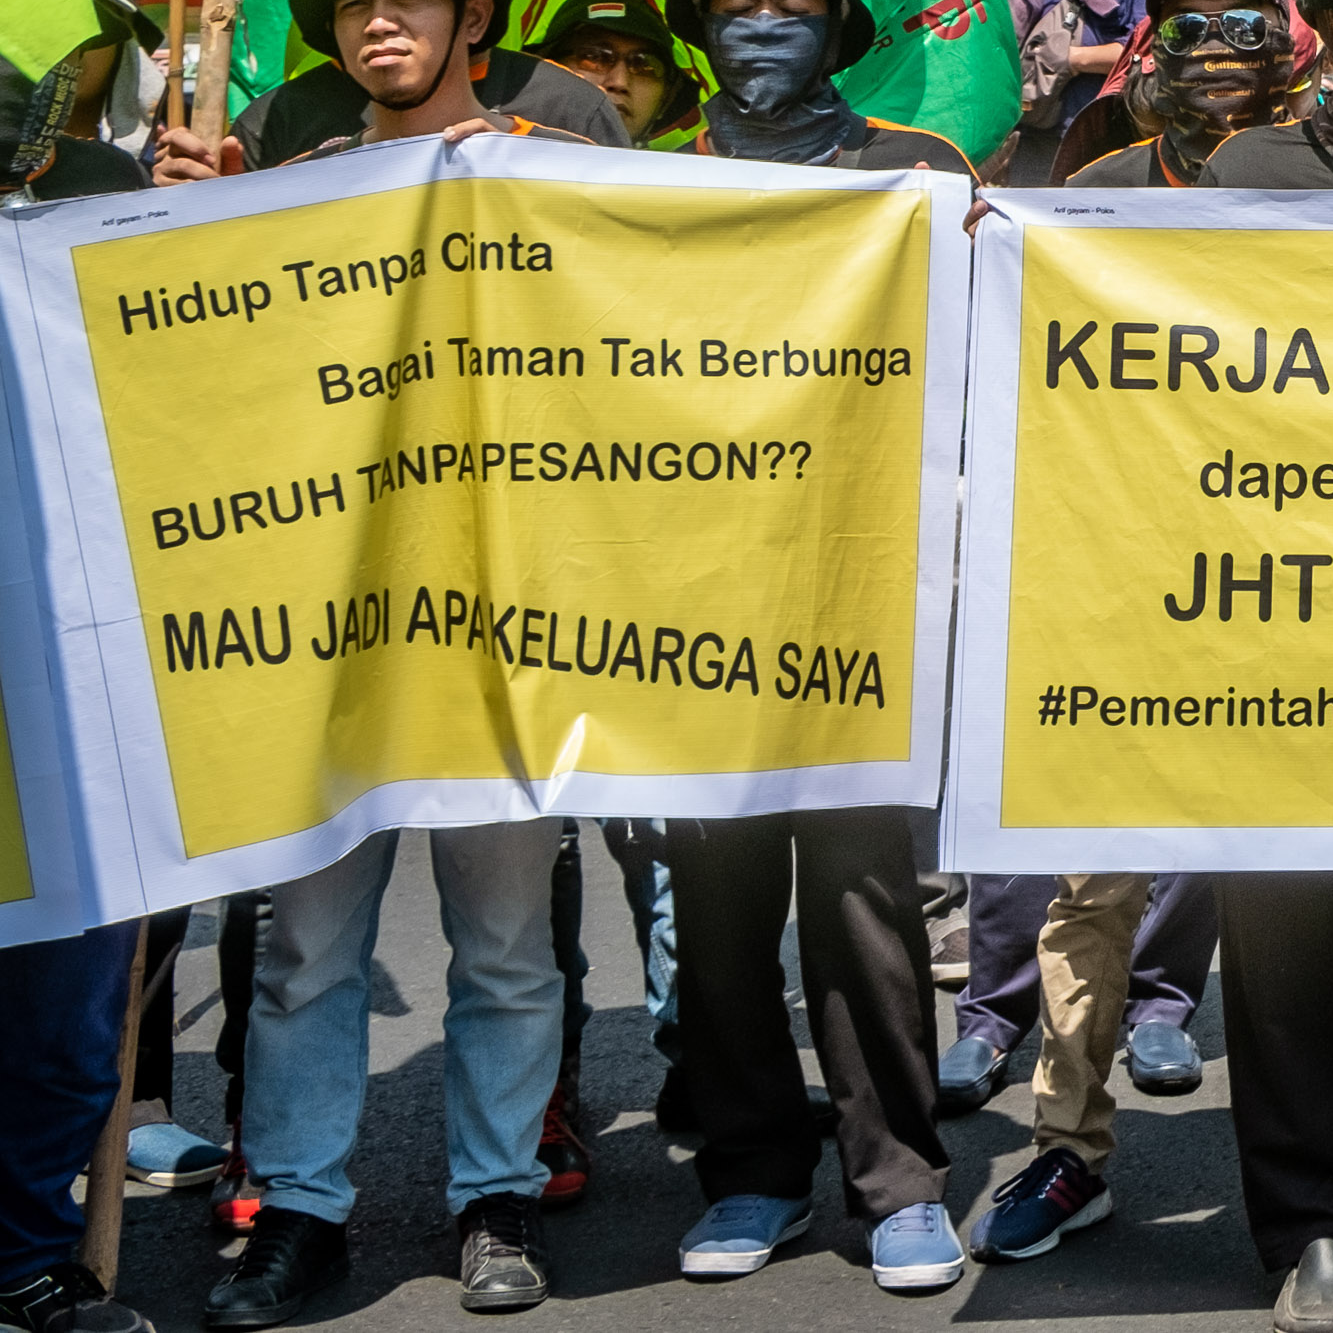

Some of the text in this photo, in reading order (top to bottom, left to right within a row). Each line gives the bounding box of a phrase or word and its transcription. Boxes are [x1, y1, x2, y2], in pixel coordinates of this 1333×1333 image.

[1204, 60, 1260, 73] Continental
[118, 232, 553, 336] Hidup Tanpa Cinta
[318, 337, 911, 405] Bagai Taman Tak Berbunga
[1046, 320, 1330, 395] KERJA
[152, 472, 345, 550] BURUH
[1164, 552, 1333, 623] JHT
[162, 604, 291, 673] MAU
[311, 588, 390, 661] JADI
[775, 641, 885, 710] SAYA
